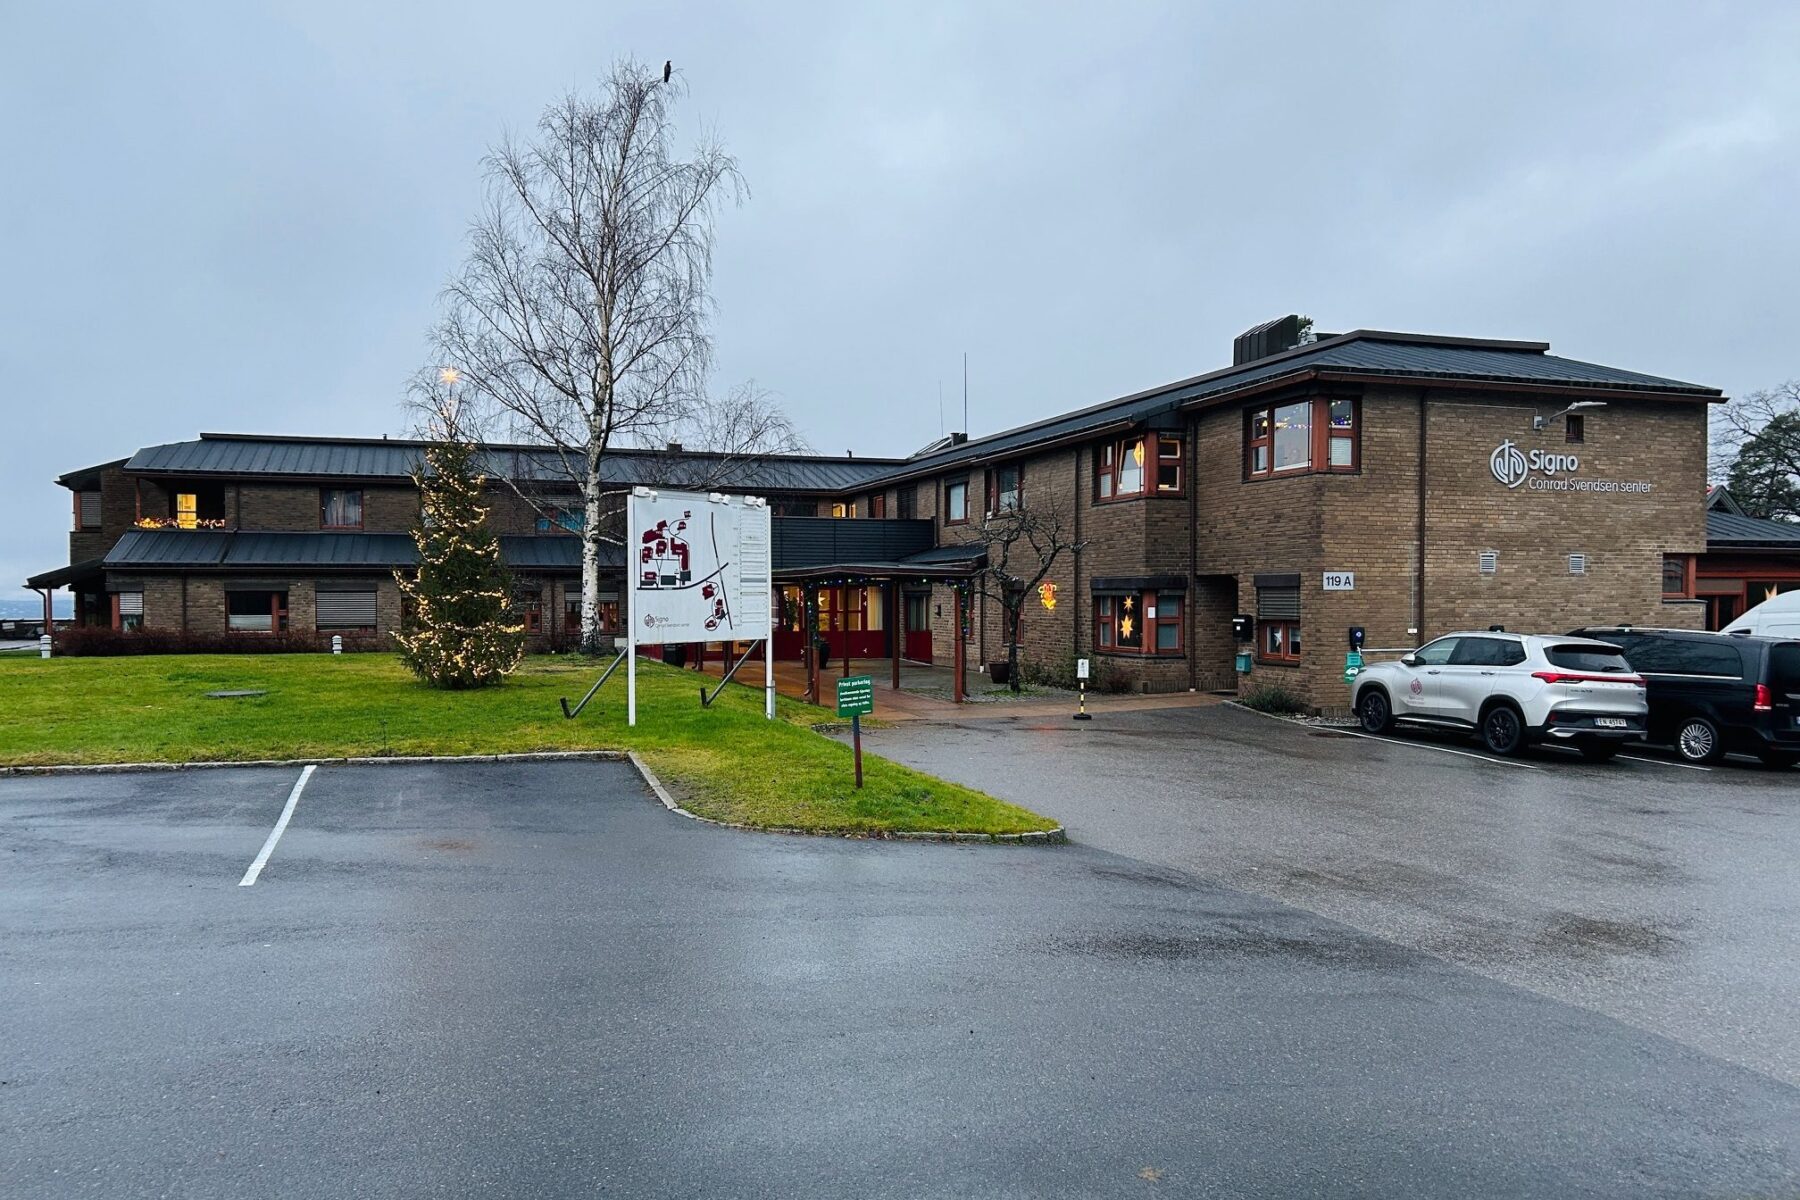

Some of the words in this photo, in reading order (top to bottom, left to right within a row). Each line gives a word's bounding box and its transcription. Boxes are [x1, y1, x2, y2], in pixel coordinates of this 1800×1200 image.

[1529, 450, 1578, 475] Signo
[1529, 477, 1568, 490] Conrad
[1569, 478, 1618, 492] Svendsen
[1620, 481, 1652, 493] senter
[1326, 576, 1341, 586] 119
[1344, 576, 1351, 586] A
